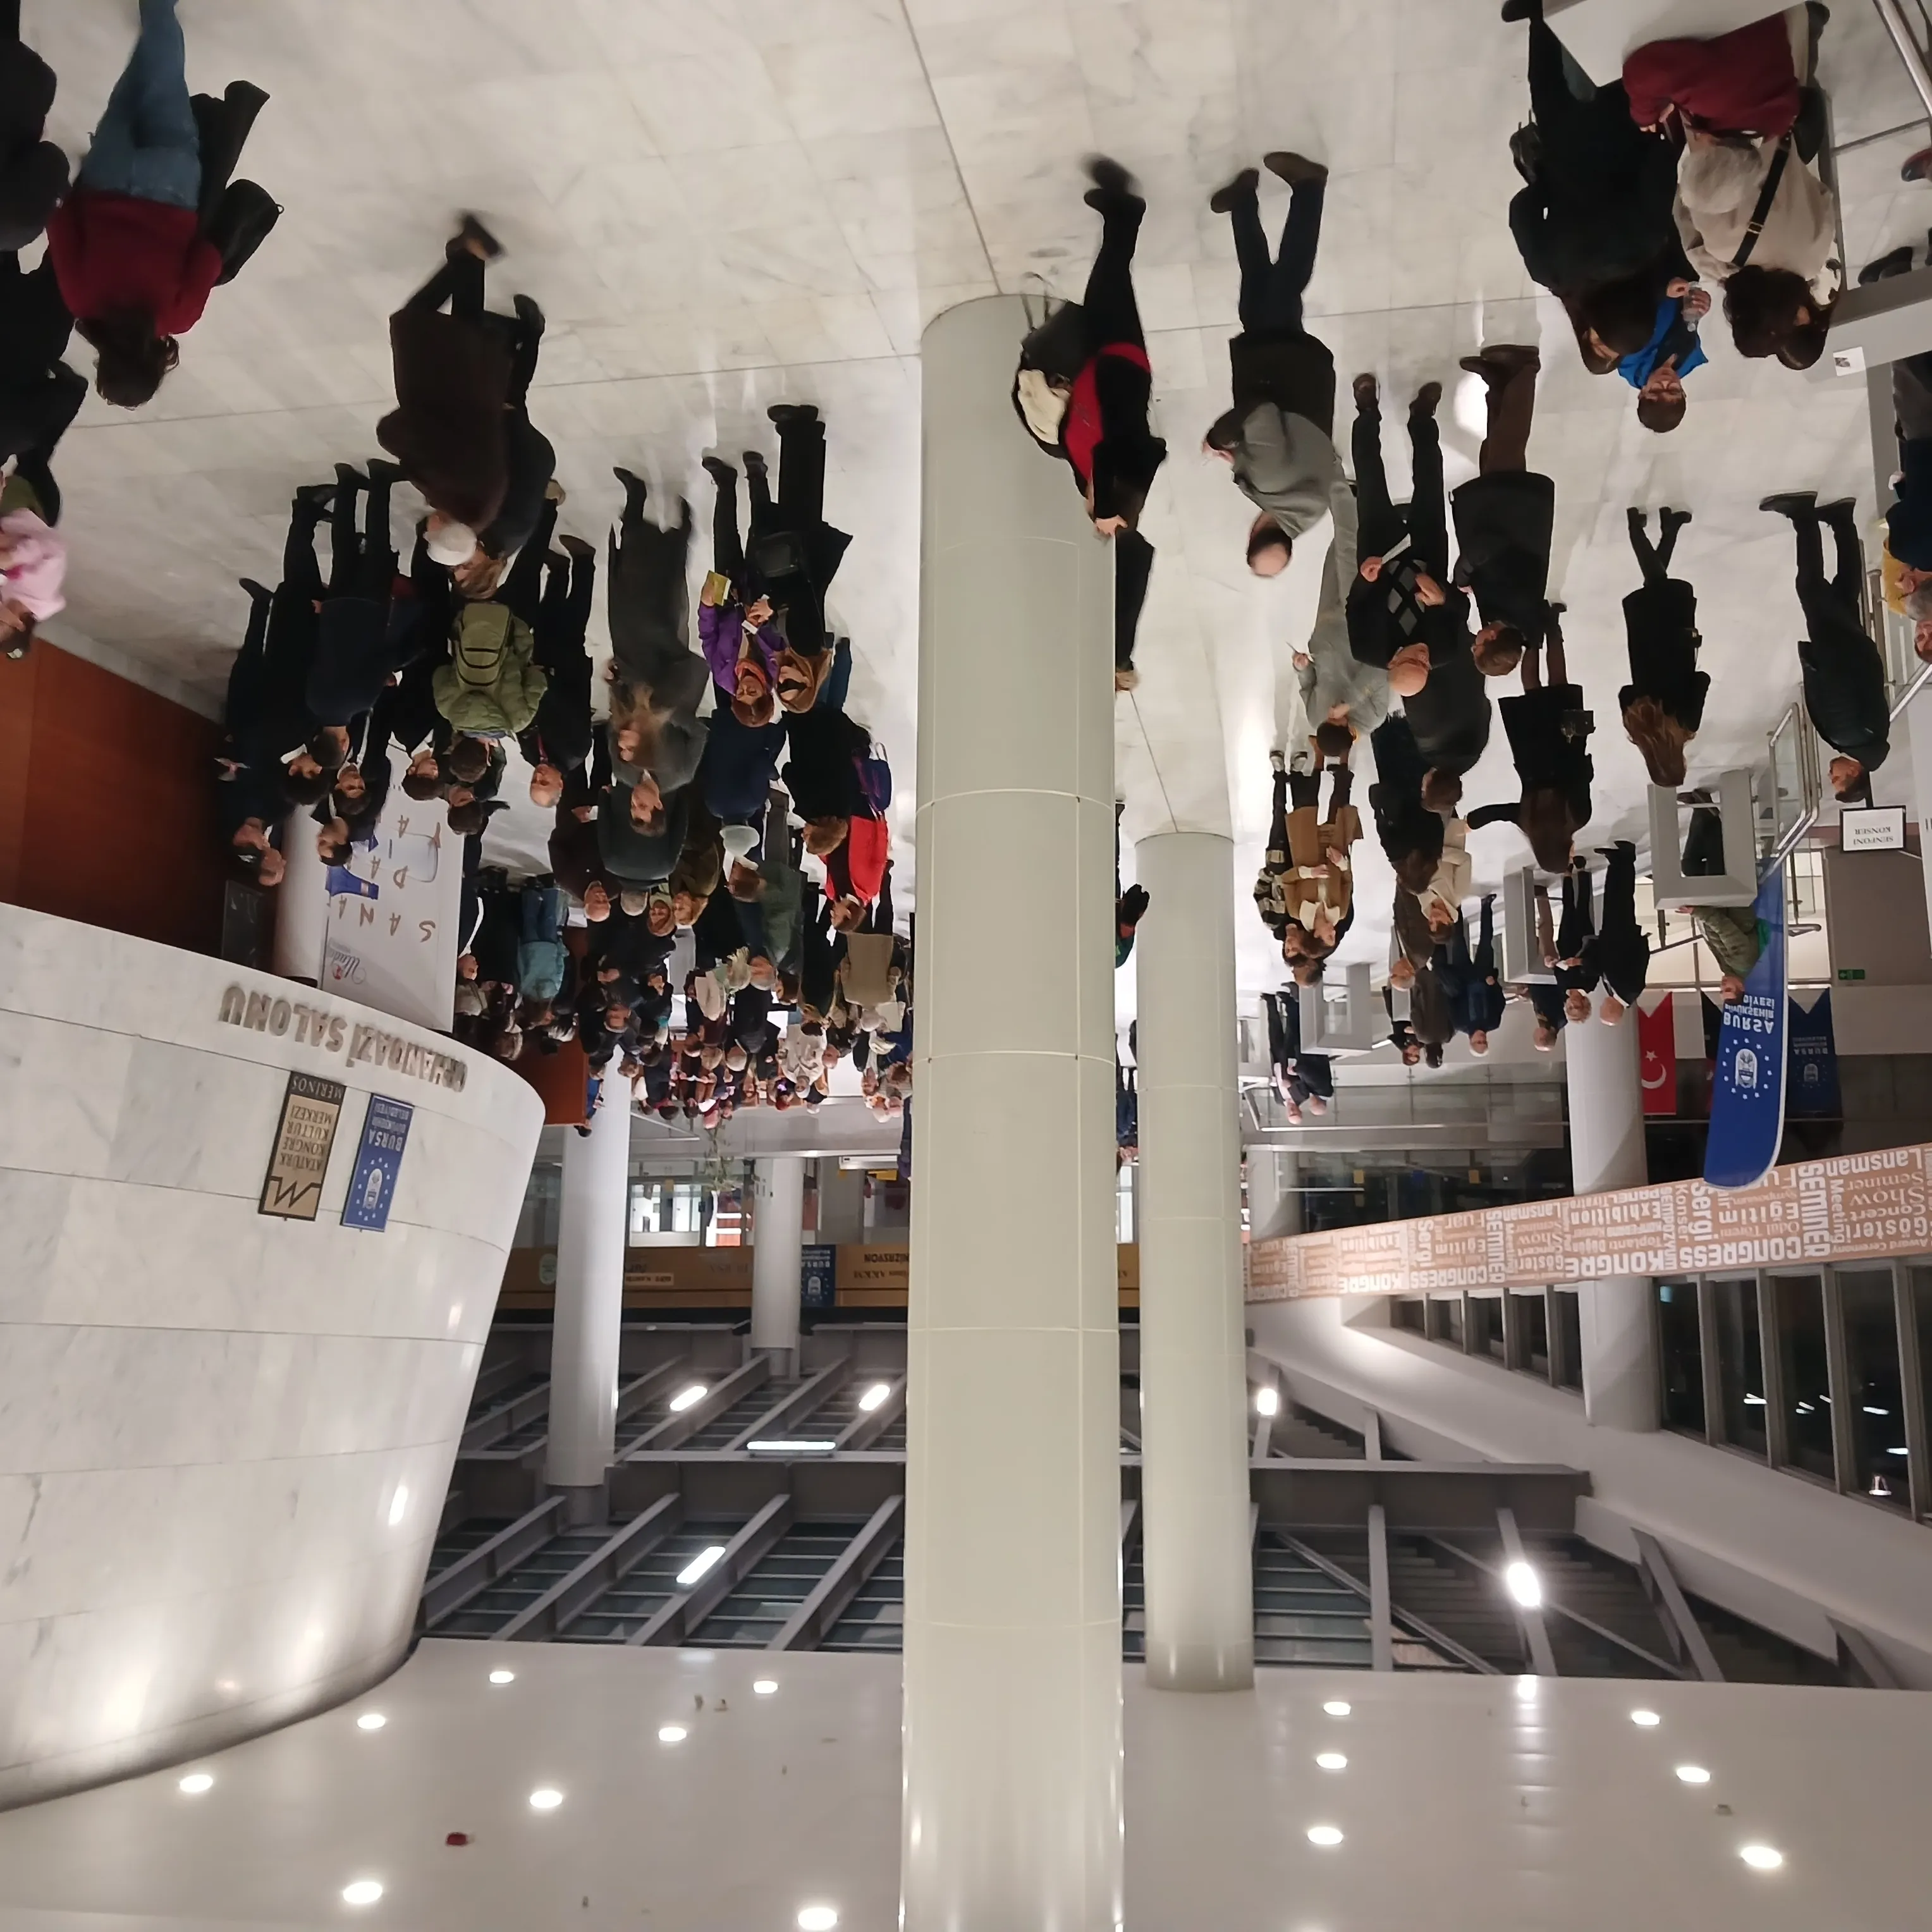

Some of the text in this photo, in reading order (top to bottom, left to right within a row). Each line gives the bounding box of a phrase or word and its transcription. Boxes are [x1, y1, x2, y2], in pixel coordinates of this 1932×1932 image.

[1855, 826, 1891, 835] KONSER
[338, 895, 436, 943] SANA
[217, 986, 348, 1053] SALONU
[290, 1075, 342, 1099] MERİNOS
[283, 1137, 324, 1156] KONGRE
[369, 1128, 403, 1152] BURSA
[1826, 1148, 1923, 1177] Lansman
[1846, 1171, 1924, 1190] Seminer
[1849, 1186, 1924, 1206] Show
[1445, 1212, 1485, 1229] Fuar
[1503, 1202, 1561, 1221] Lansman
[1570, 1201, 1661, 1226] Exhibition
[1675, 1184, 1689, 1242] Konser
[1688, 1182, 1718, 1241] Sergi
[1718, 1201, 1799, 1225] Eğitim
[1829, 1179, 1847, 1244] Meeting
[1849, 1204, 1926, 1221] Concert
[1517, 1232, 1563, 1247] Show
[1845, 1217, 1928, 1244] Gösteri
[1415, 1220, 1436, 1267] Sergi
[1435, 1237, 1486, 1256] Eğitim
[1679, 1237, 1801, 1268] CONGRESS
[1831, 1238, 1928, 1253] Award Ceremony
[1515, 1254, 1563, 1273] Gösteri
[1564, 1250, 1664, 1278] KONGRE
[1338, 1271, 1402, 1294] KONGRE
[1410, 1265, 1487, 1289] CONGRESS
